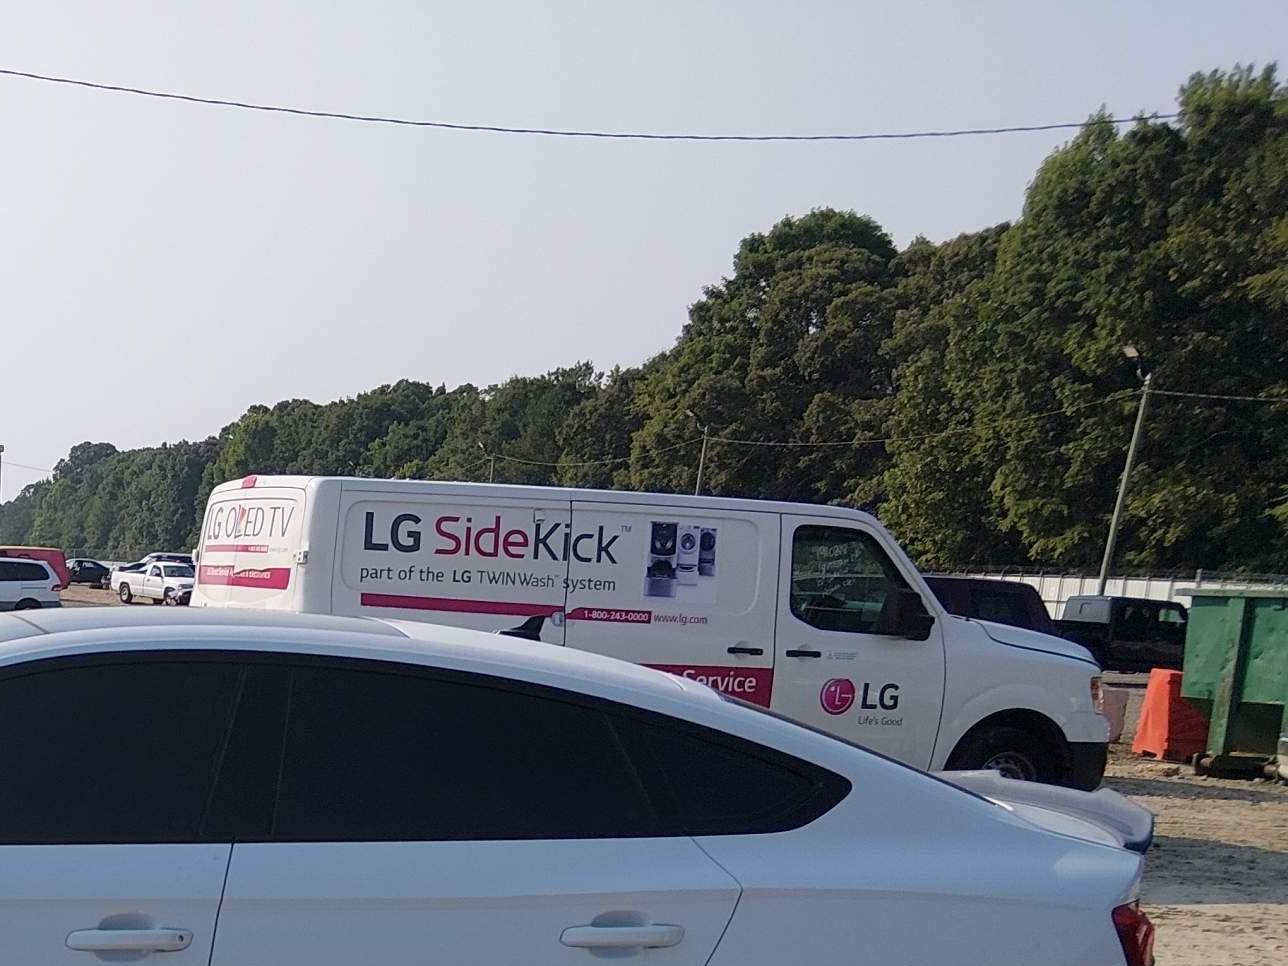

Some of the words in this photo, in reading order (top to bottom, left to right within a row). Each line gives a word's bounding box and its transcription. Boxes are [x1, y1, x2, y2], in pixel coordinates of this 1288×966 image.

[208, 507, 223, 540] LG
[226, 505, 264, 538] OLED
[269, 506, 295, 538] TV
[363, 512, 422, 553] LG
[433, 515, 620, 564] SideKick
[360, 566, 393, 583] part
[398, 565, 415, 580] of
[419, 567, 444, 582] the
[452, 570, 472, 583] LG
[563, 575, 616, 593] system
[583, 609, 649, 622] 1-800-243-0000
[653, 613, 708, 626] www.lg.com
[861, 682, 900, 710] LG
[857, 715, 879, 726] Life's
[881, 717, 903, 727] Good
